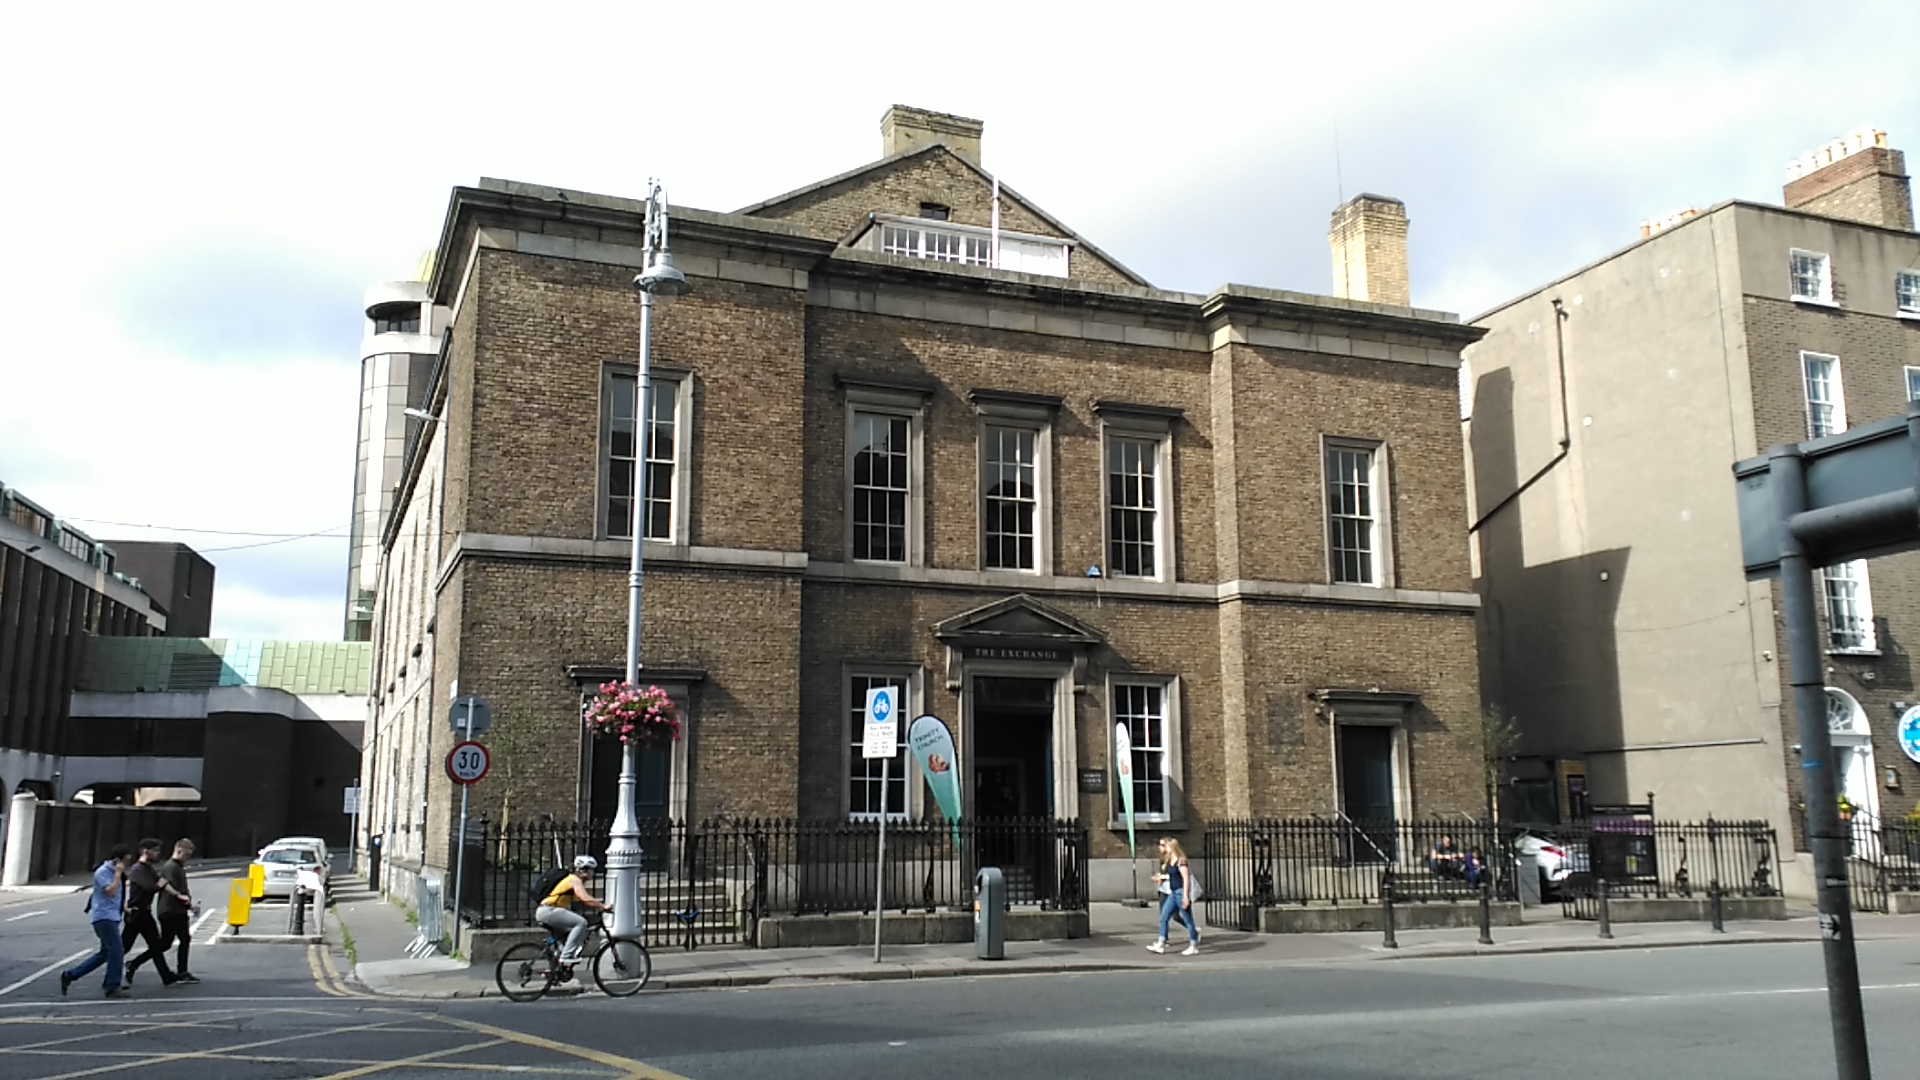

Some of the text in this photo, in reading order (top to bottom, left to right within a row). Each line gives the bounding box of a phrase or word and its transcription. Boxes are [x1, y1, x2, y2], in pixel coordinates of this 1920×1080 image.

[975, 648, 1057, 659] THE EXCHANGE
[915, 728, 939, 743] TRINITY
[917, 735, 944, 750] CHURCH
[459, 751, 480, 770] 30
